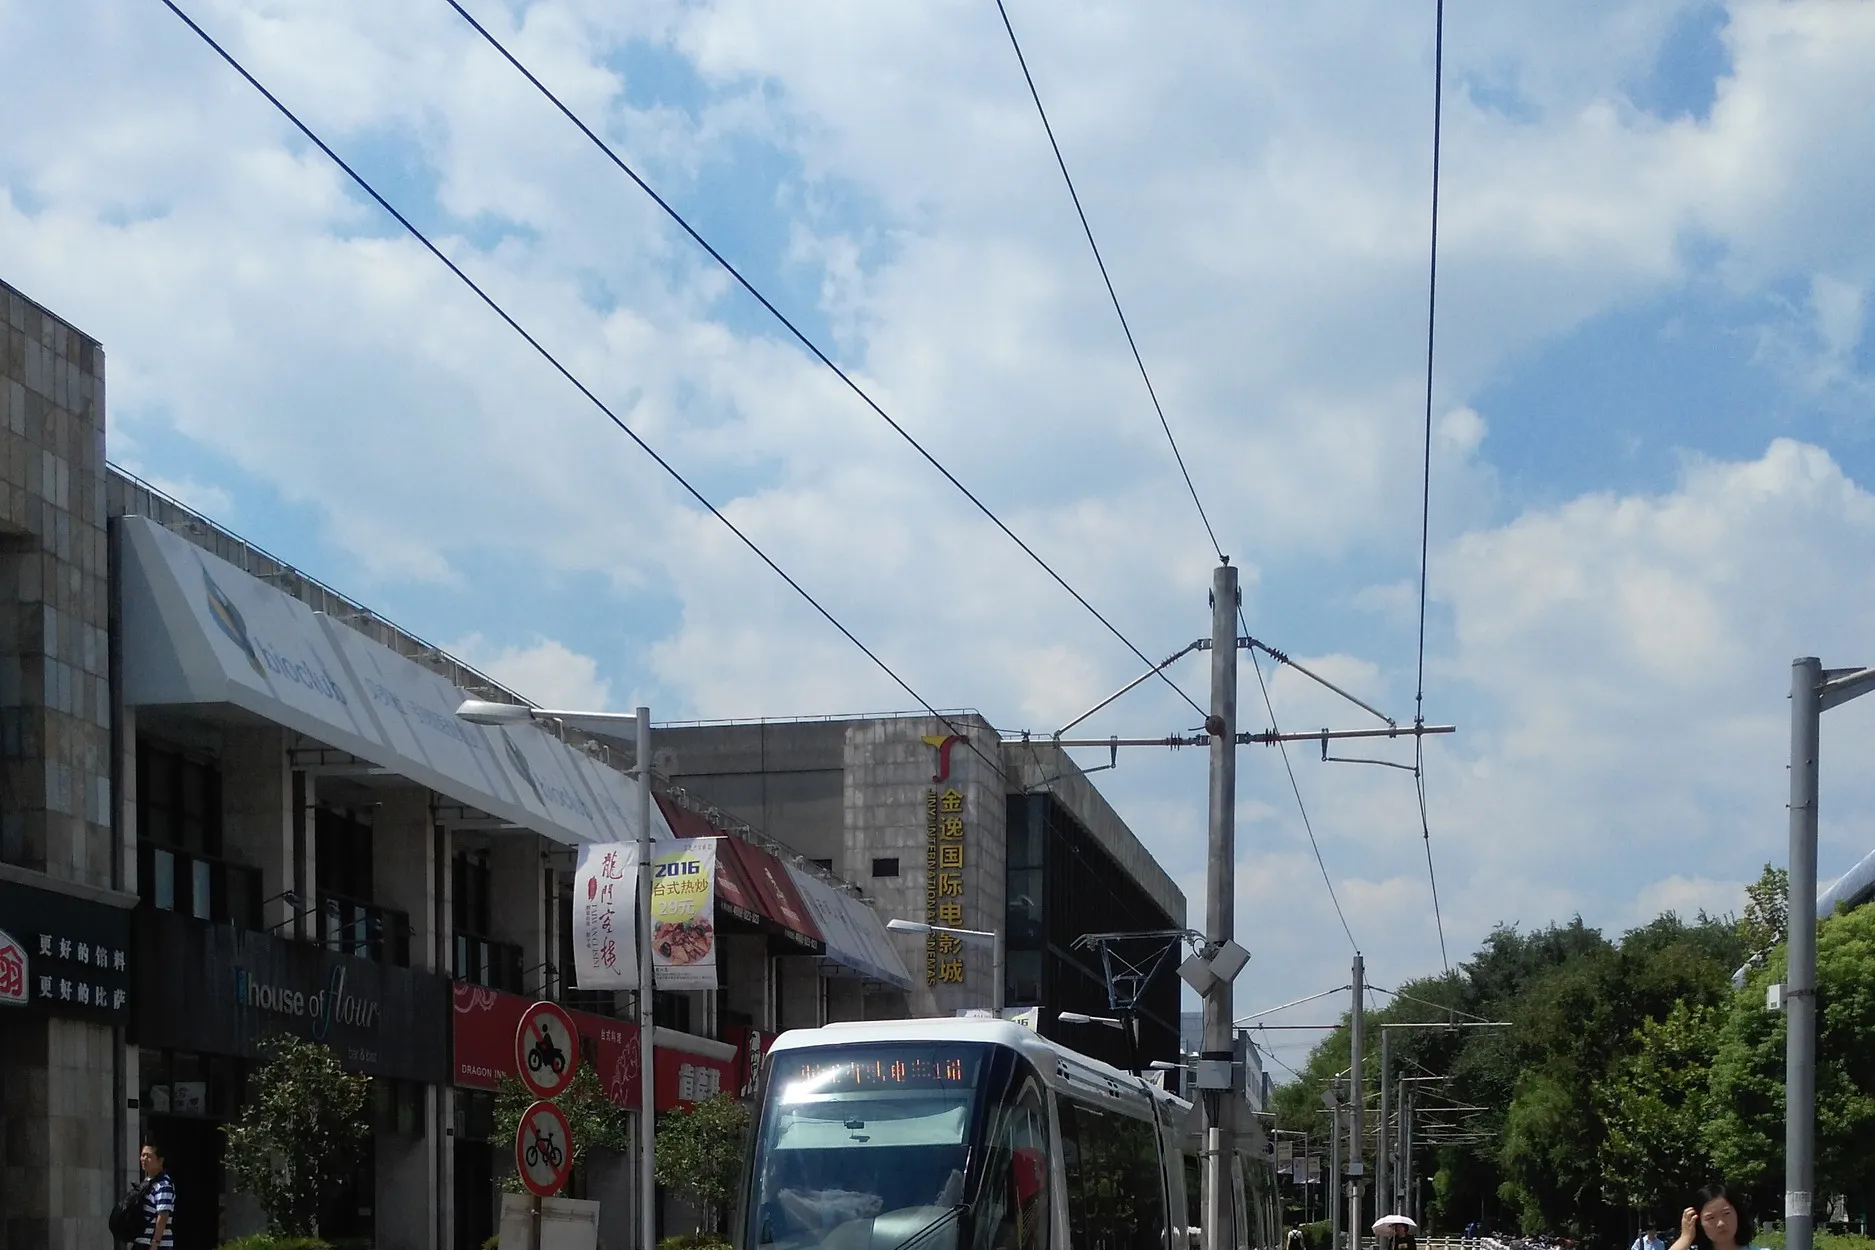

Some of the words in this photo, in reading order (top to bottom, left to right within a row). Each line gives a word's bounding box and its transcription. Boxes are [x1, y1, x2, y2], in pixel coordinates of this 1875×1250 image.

[655, 860, 700, 878] 2016
[654, 878, 709, 897] 台式热炒
[938, 788, 964, 983] 金逸国际电影城
[659, 899, 696, 916] 29元
[39, 933, 126, 972] 更好的馅料
[39, 975, 126, 1010] 更好的比萨
[248, 972, 305, 1016] house
[309, 989, 325, 1019] of
[312, 965, 380, 1040] flour
[462, 1066, 492, 1078] DRAGON
[495, 1070, 507, 1079] INN
